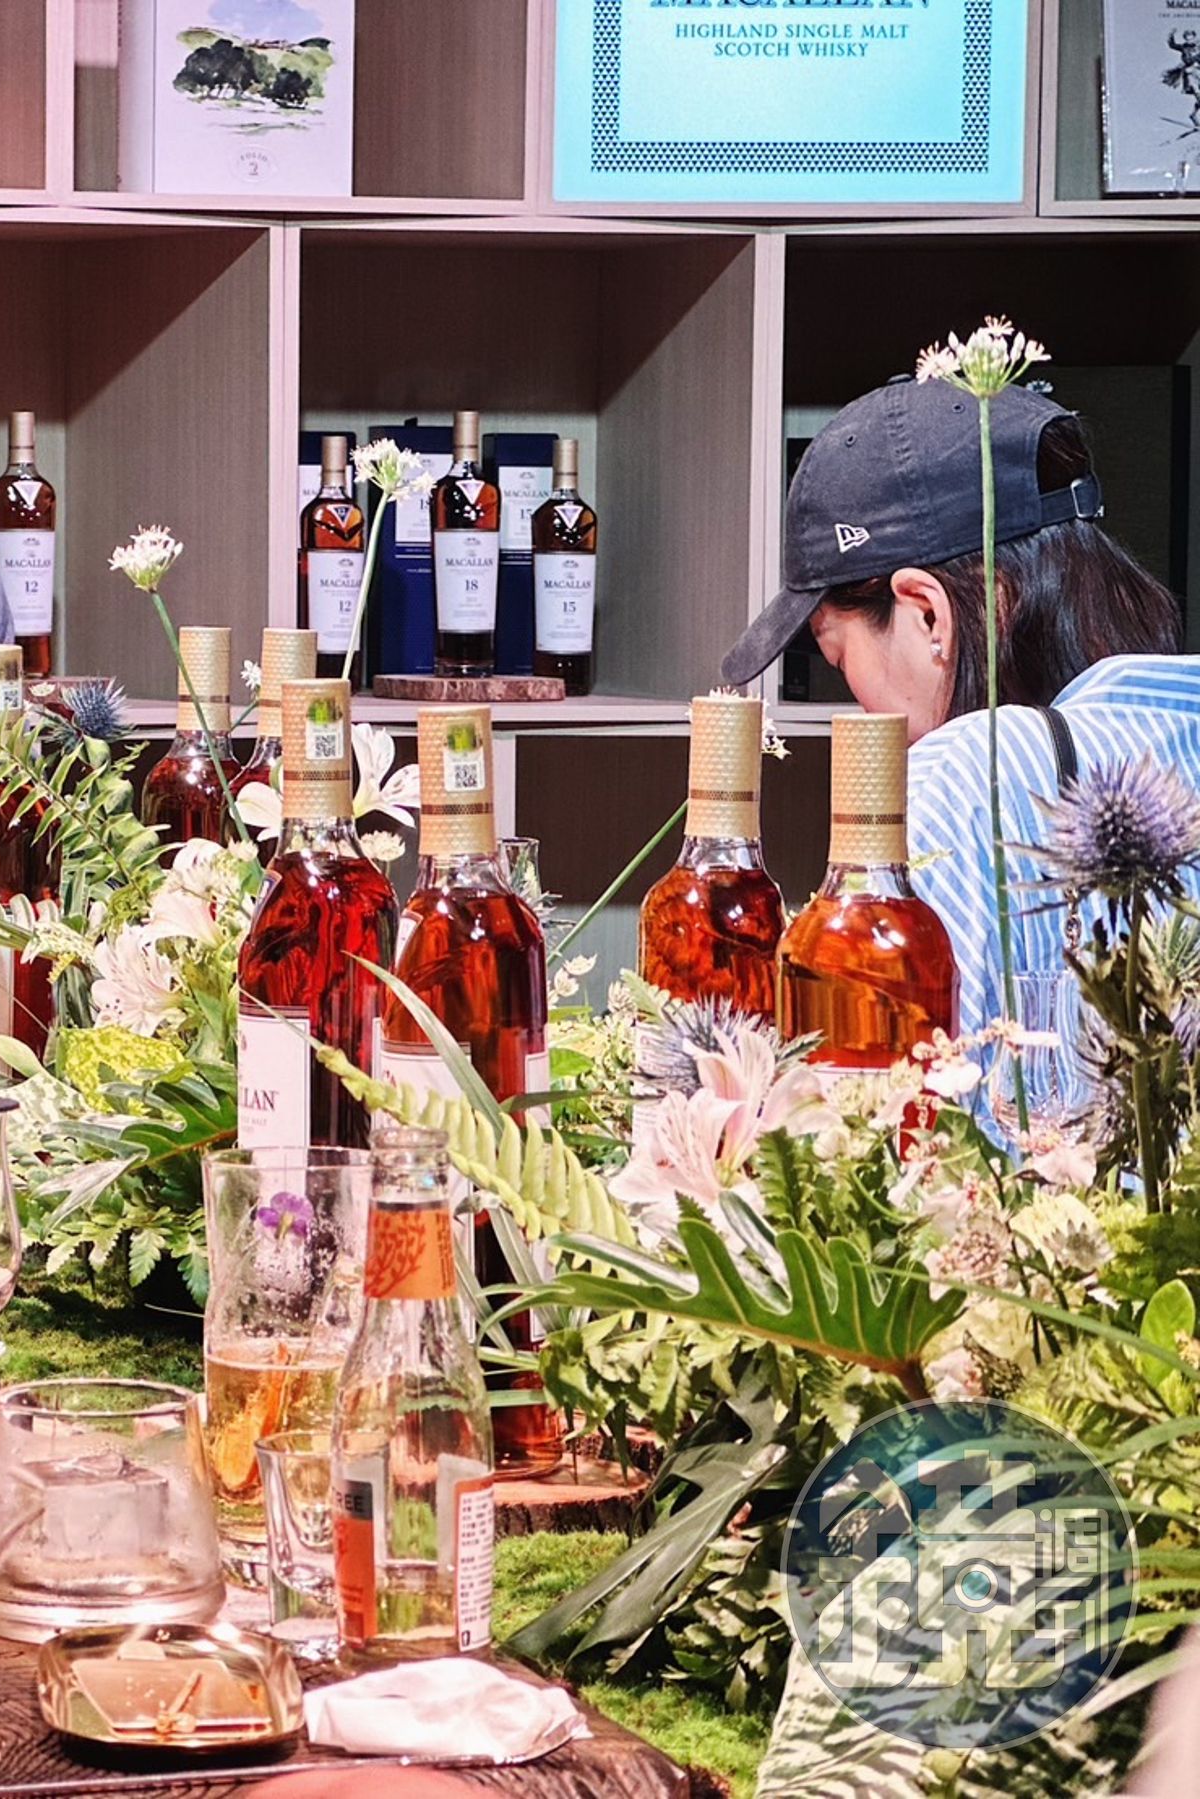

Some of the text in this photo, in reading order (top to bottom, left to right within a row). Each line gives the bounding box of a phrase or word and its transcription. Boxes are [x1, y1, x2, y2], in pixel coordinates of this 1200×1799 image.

[675, 24, 909, 39] HIGHLAND SINGLE MALT
[714, 42, 869, 57] SCOTCH WHISKY
[248, 161, 259, 176] 2
[25, 581, 38, 593] 12
[320, 579, 361, 588] MACALLA
[465, 579, 479, 592] 18
[339, 600, 351, 612] 12
[563, 601, 576, 613] 15
